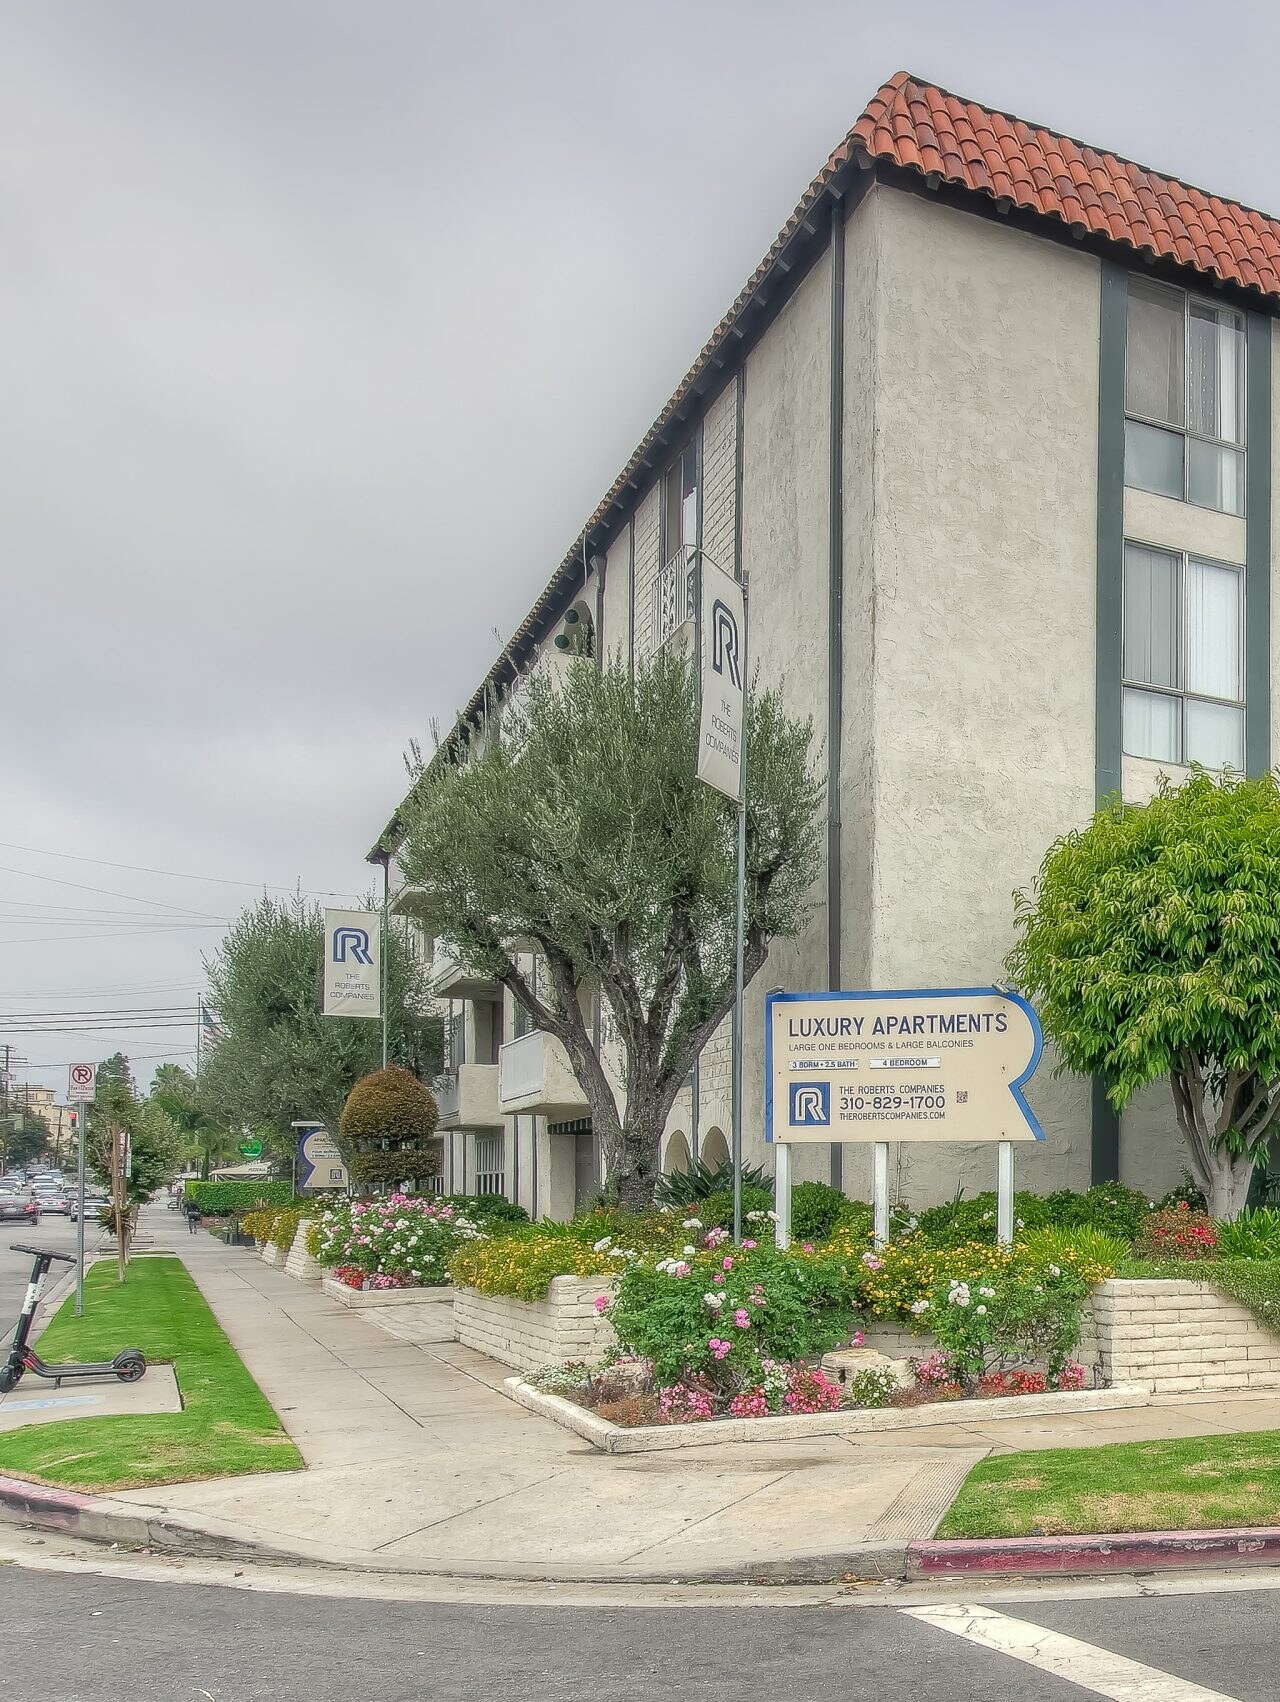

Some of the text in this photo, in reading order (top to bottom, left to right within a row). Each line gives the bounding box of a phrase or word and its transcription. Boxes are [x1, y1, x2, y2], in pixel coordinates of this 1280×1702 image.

[720, 698, 731, 717] THE
[711, 714, 736, 742] ROBERTS
[705, 732, 739, 765] COMPANIES
[334, 982, 370, 990] ROBERTS
[329, 991, 375, 1000] COMPANIES
[788, 1012, 1009, 1037] LUXURY APARTMENTS
[788, 1039, 974, 1052] LARGE ONE BEDROOMS & LARGE BALCONIES
[792, 1061, 797, 1069] 3
[889, 1058, 928, 1066] BEDROOM
[839, 1084, 945, 1095] THE ROBERTS COMPANIES
[840, 1096, 946, 1110] 310-829-1700
[839, 1111, 945, 1120] THEROBERTSCOMPANIES.COM
